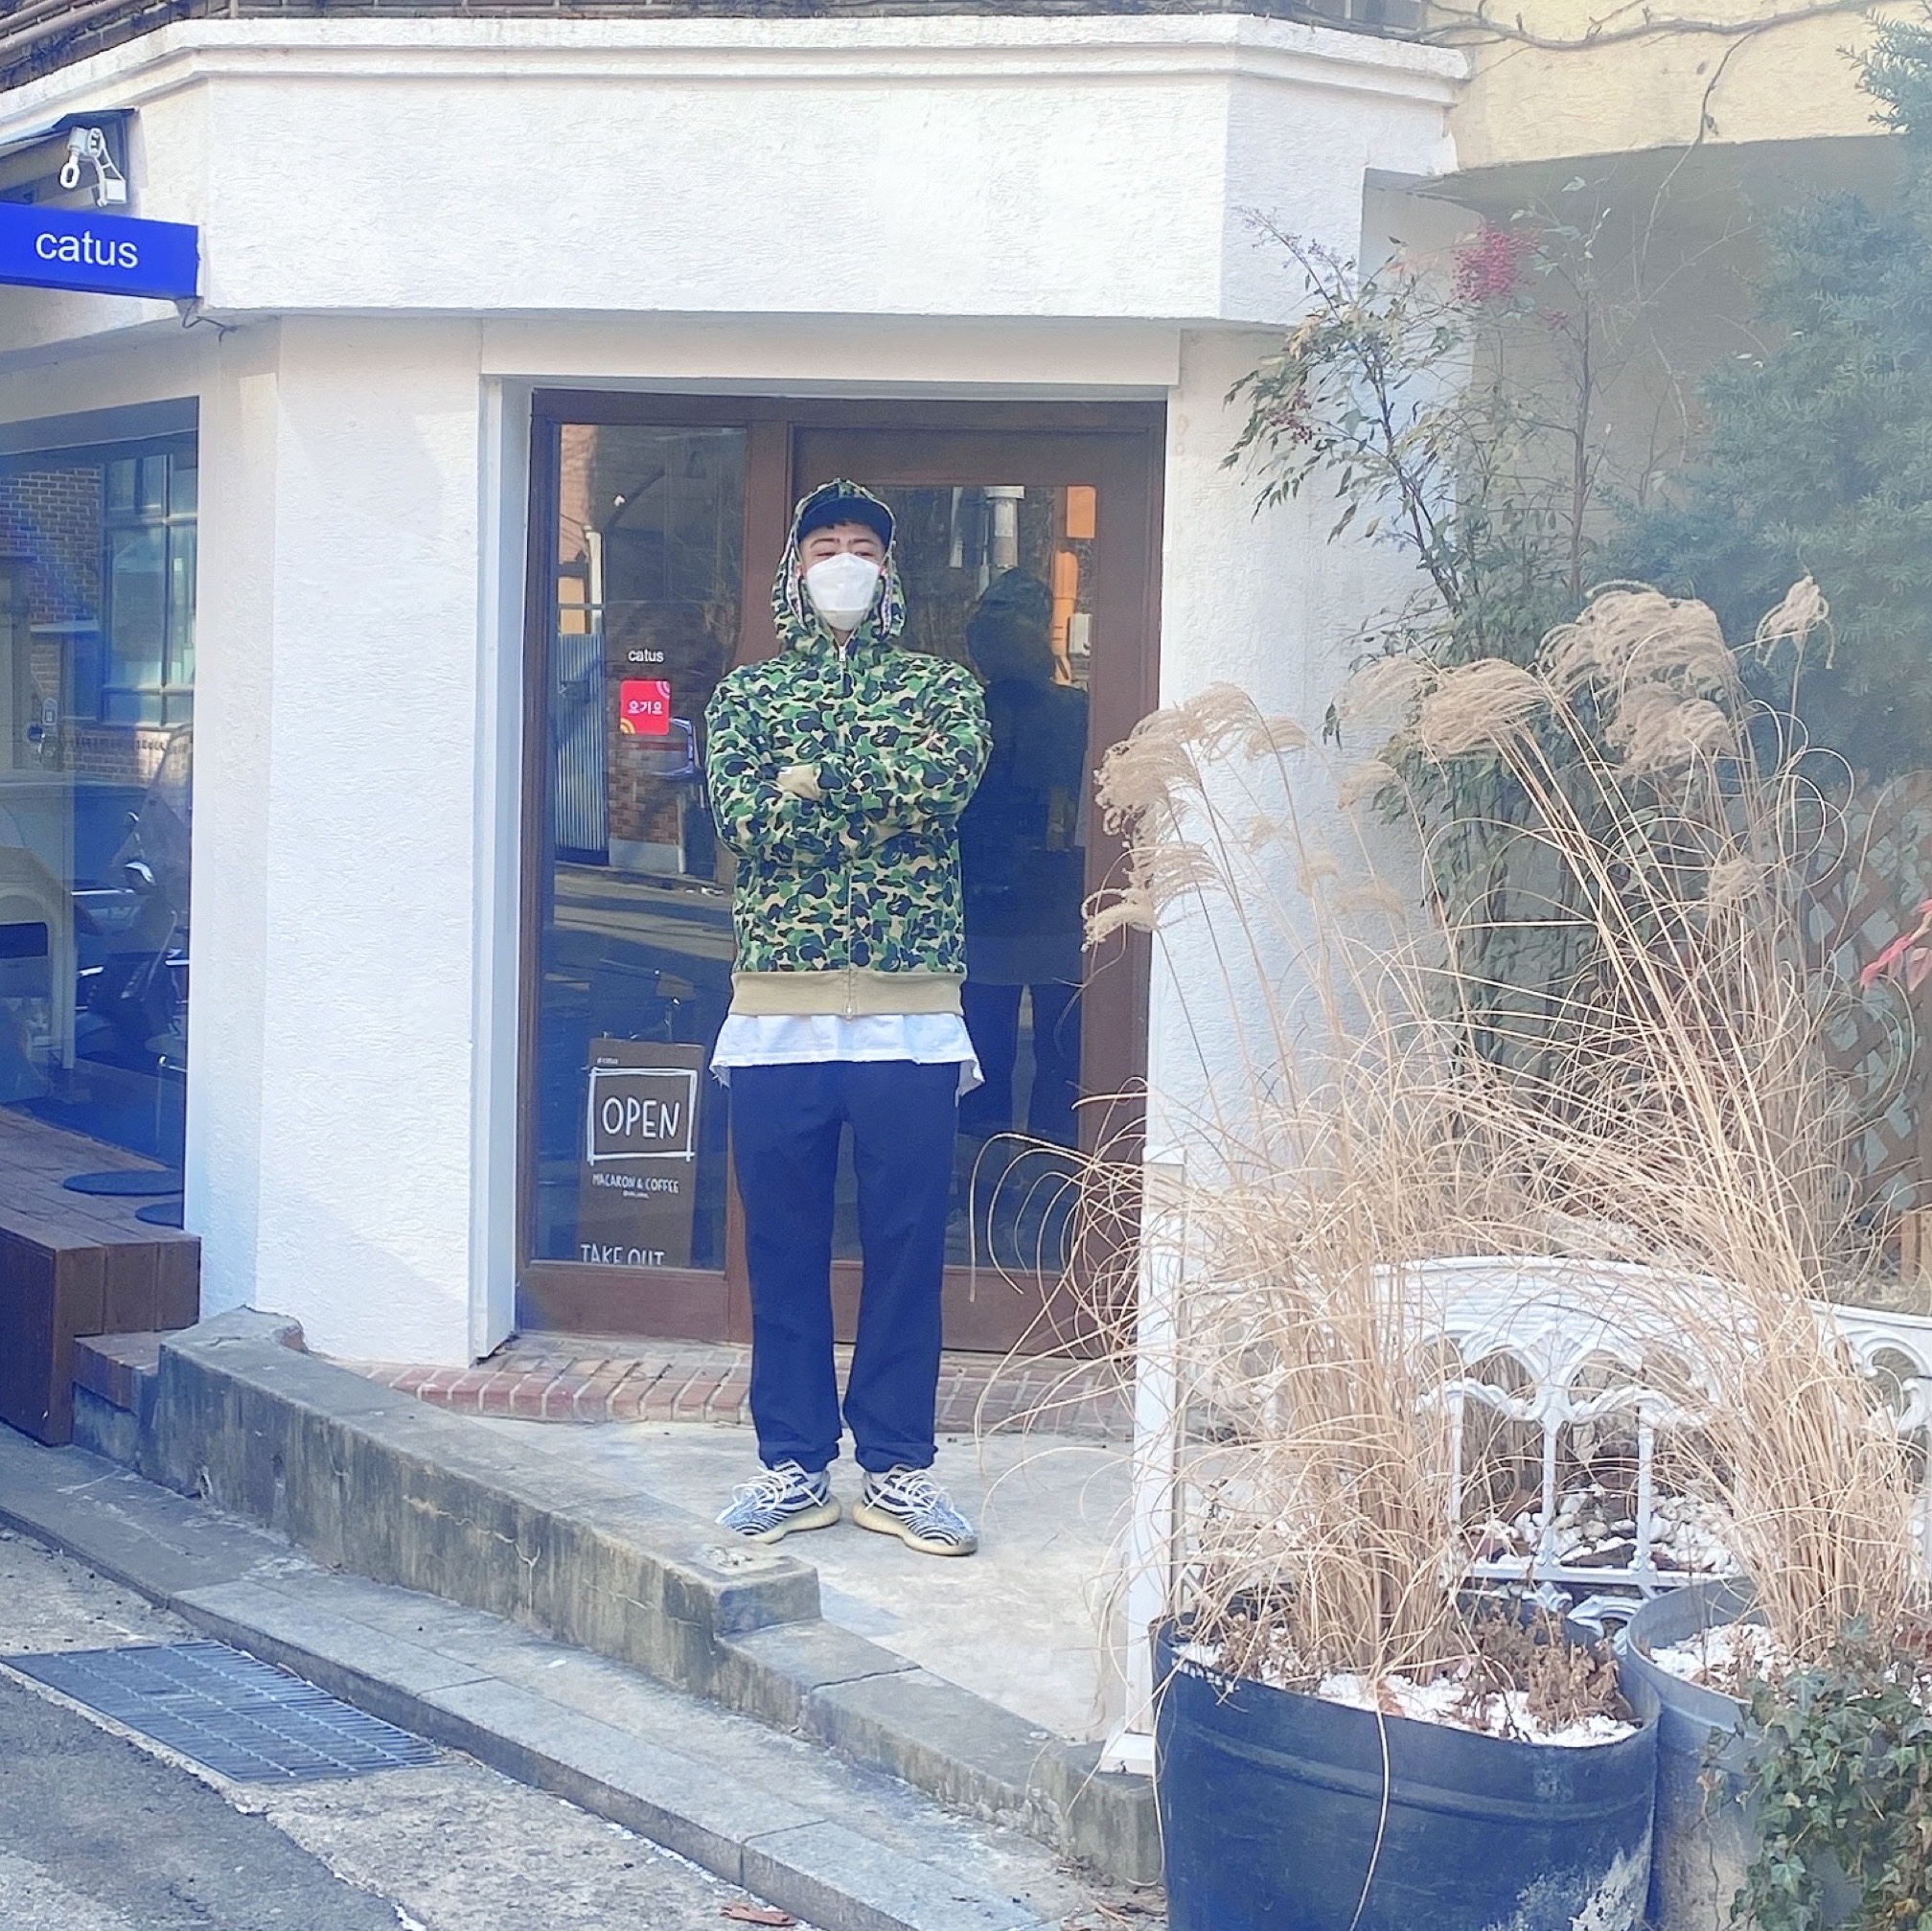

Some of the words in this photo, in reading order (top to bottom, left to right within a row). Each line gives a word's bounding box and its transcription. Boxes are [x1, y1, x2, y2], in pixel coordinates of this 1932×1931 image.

[35, 230, 139, 269] catus
[628, 648, 665, 663] catus
[628, 700, 663, 715] 요기요
[602, 1096, 680, 1139] OPEN
[591, 1172, 636, 1188] MACARON
[644, 1177, 679, 1194] COFFEE
[580, 1242, 624, 1264] TAKE
[627, 1248, 665, 1266] OUT
